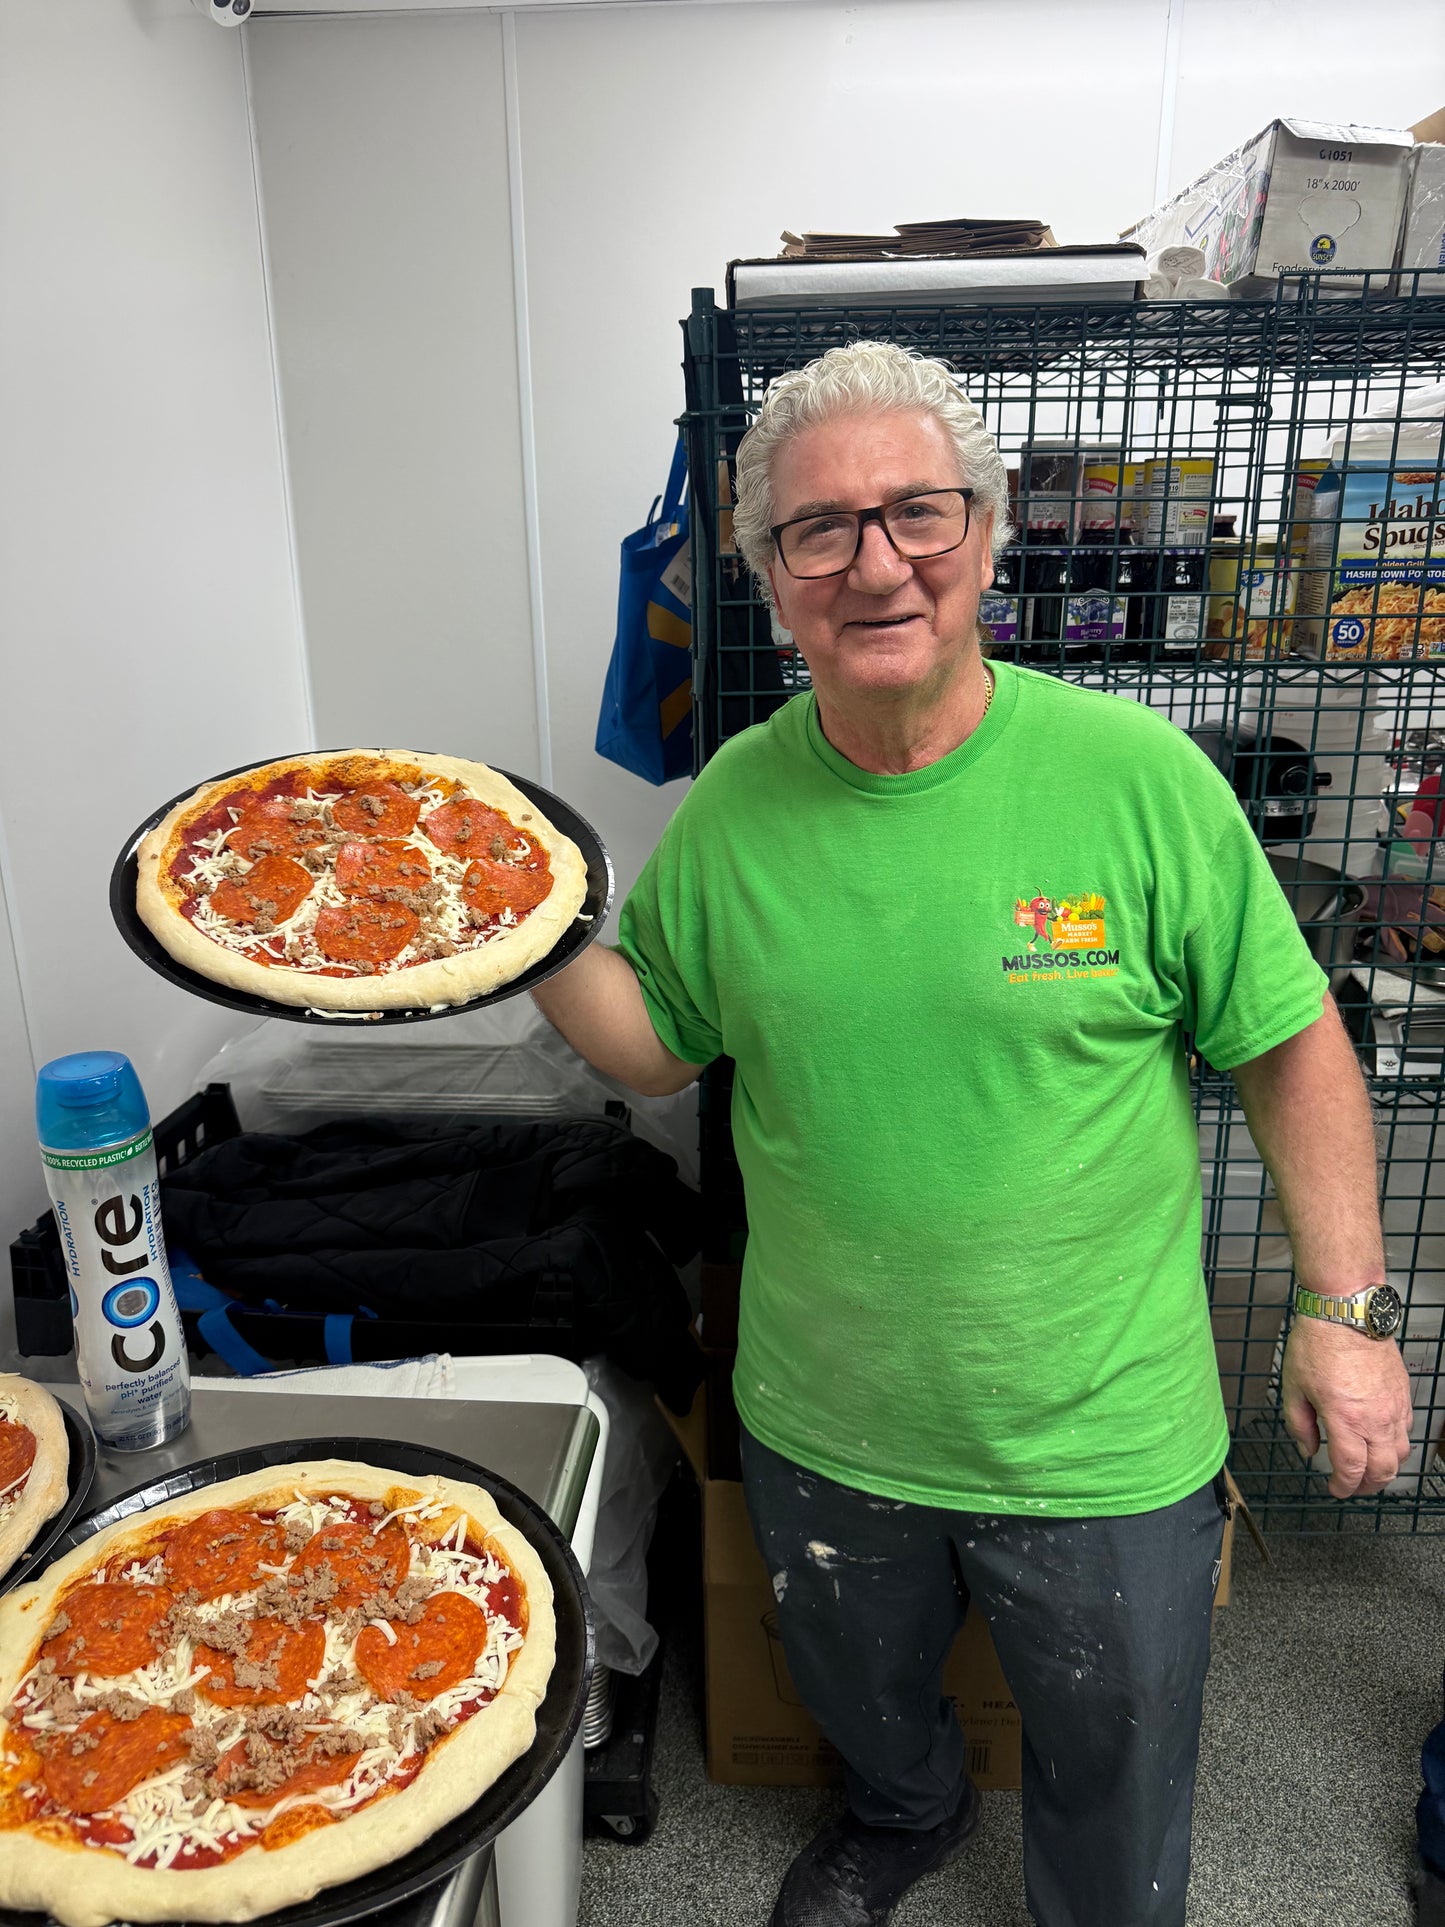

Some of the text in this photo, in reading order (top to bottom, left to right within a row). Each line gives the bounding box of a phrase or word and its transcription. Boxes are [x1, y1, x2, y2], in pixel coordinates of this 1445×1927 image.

[1312, 253, 1334, 261] SUNSET
[1407, 568, 1445, 578] POATOE
[1337, 624, 1361, 641] 50
[1061, 921, 1098, 932] Musso's
[1002, 950, 1120, 971] MUSSOS.COM
[1009, 972, 1029, 984] Eat
[1032, 970, 1064, 982] fresh.
[1066, 968, 1089, 979] Live
[46, 1155, 61, 1166] 100%
[62, 1158, 98, 1169] RECYCLED
[142, 1184, 159, 1262] HYDRATION
[56, 1200, 81, 1277] HYDRATION
[94, 1193, 166, 1373] core
[105, 1377, 146, 1392] perfectly
[148, 1356, 181, 1383] balanced
[141, 1373, 174, 1396] purified
[137, 1390, 163, 1405] water
